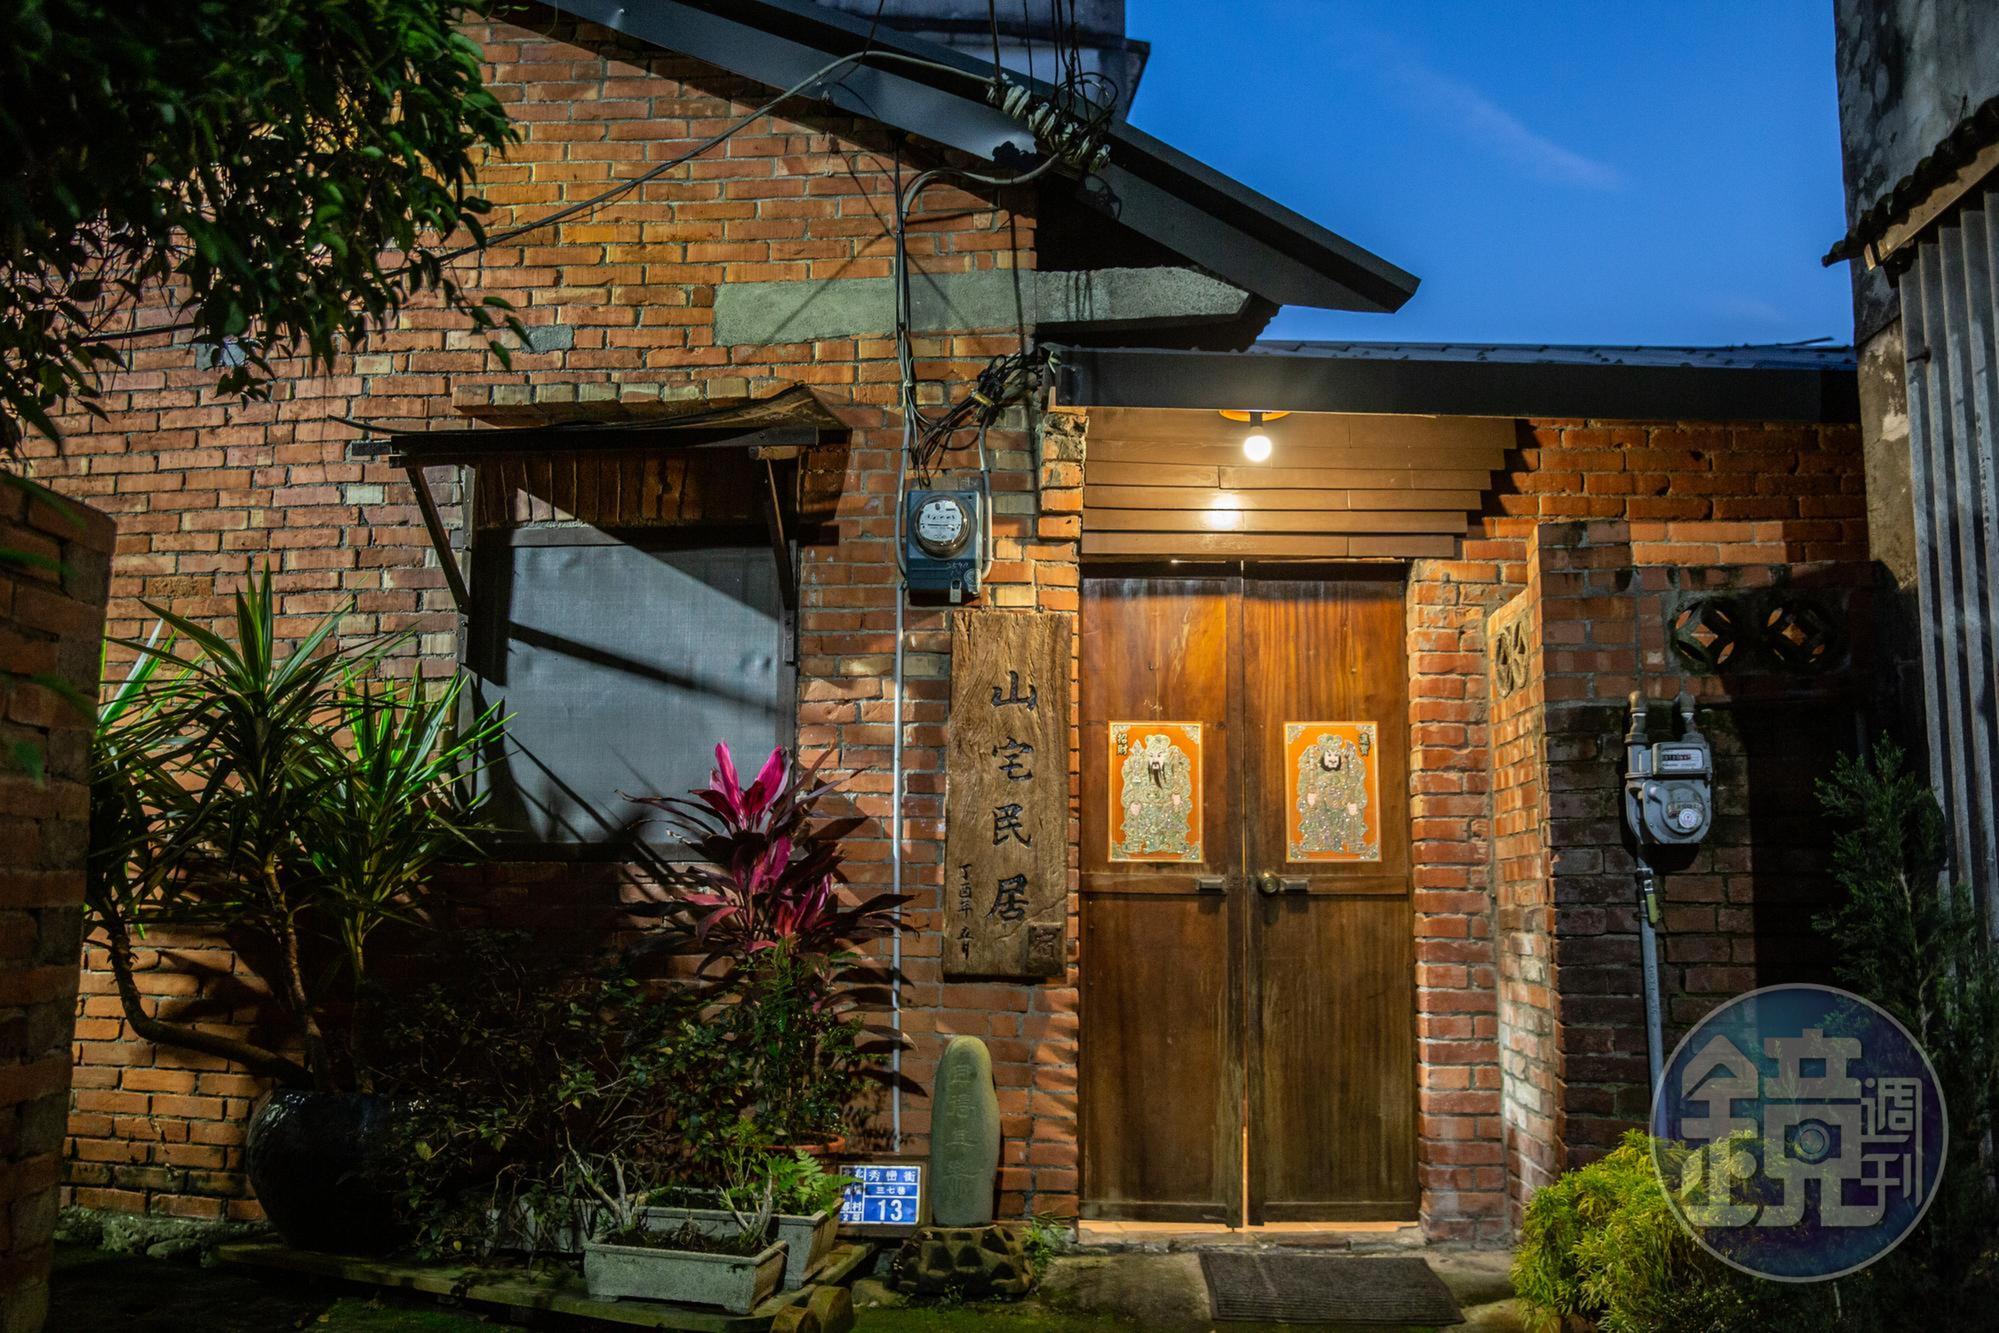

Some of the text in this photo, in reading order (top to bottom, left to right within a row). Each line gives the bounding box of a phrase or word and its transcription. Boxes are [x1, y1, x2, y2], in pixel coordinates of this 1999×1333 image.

[984, 670, 1038, 921] 山宅民居
[877, 1199, 903, 1222] 13
